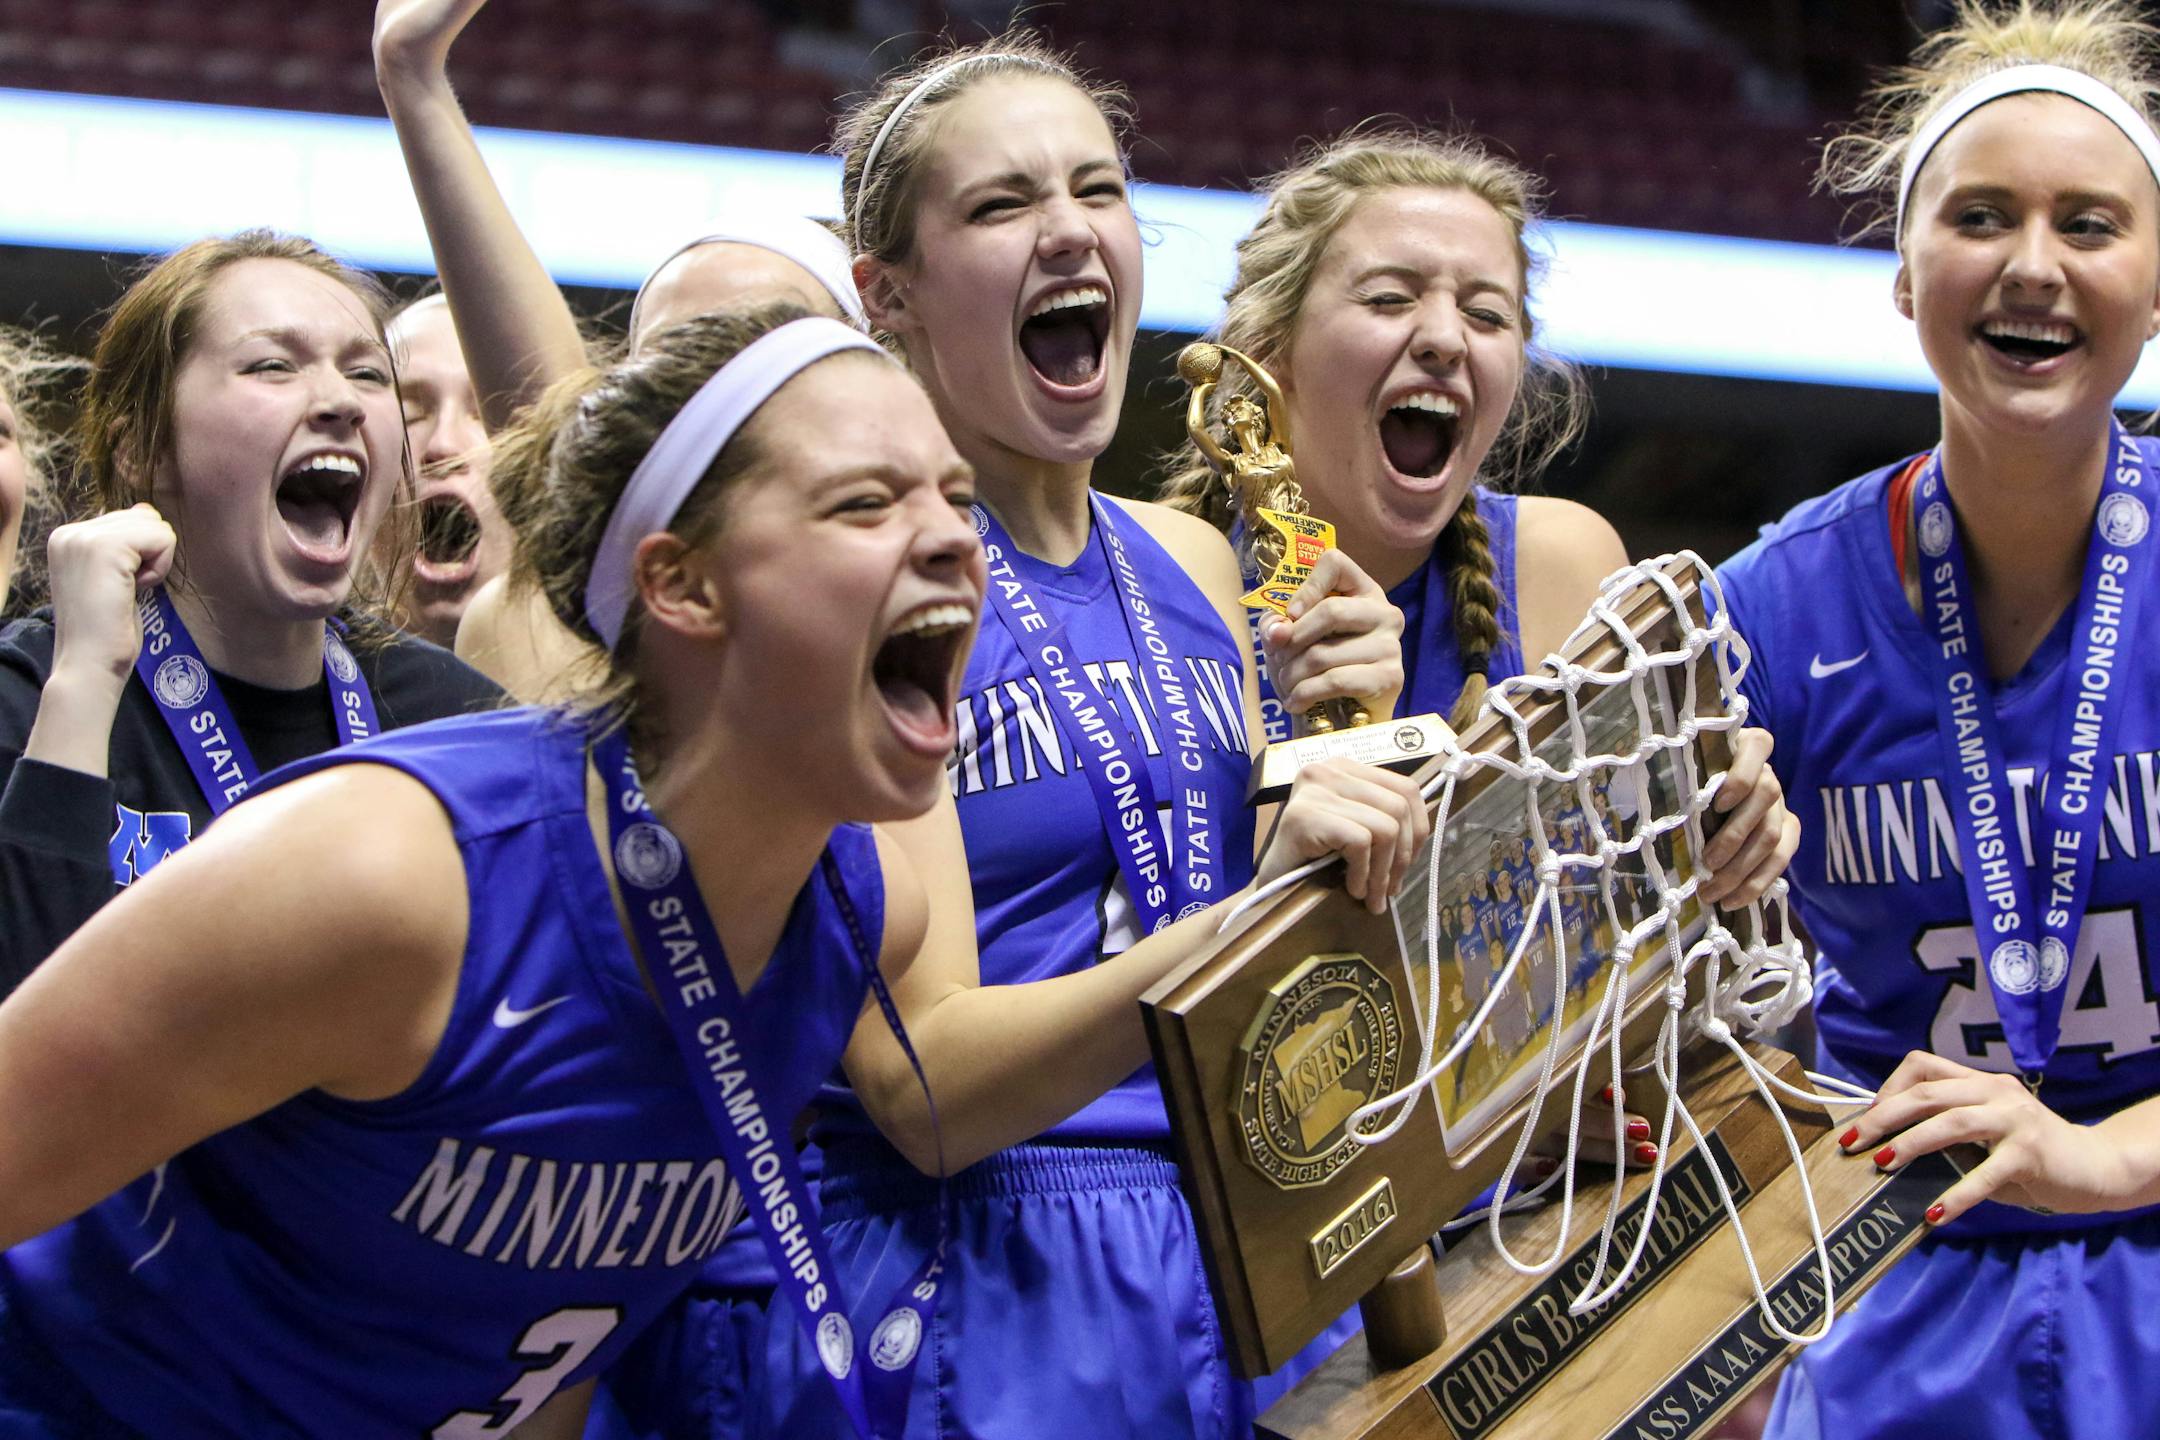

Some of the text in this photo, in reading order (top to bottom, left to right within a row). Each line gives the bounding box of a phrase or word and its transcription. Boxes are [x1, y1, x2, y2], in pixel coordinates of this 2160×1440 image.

[1106, 532, 1203, 772] CHAMPIONSHIPS
[1933, 561, 1967, 660] STATE
[984, 543, 1167, 908] STATE CHAMPIONSHIPS
[2060, 553, 2129, 815] CHAMPIONSHIPS
[190, 711, 250, 804] STATE
[1947, 670, 2021, 934] CHAMPIONSHIPS
[1184, 788, 1212, 893] STATE
[2046, 829, 2082, 929] STATE
[1506, 913, 1517, 930] 12
[1532, 950, 1543, 967] 10
[1253, 965, 1360, 1062] MINNESOTA
[1294, 994, 1324, 1026] ARTS
[1915, 908, 2160, 1074] 24
[649, 896, 828, 1313] STATE CHAMPIONSHIPS
[1244, 1116, 1280, 1173] STATE
[1277, 1161, 1323, 1182] HIGH
[1379, 1001, 1399, 1093] LEAGUE
[1274, 1019, 1369, 1126] MSHSL
[1321, 1191, 1391, 1268] 2016
[1685, 1332, 1769, 1414] AAAA
[1758, 1199, 1906, 1340] CHAMPION
[431, 1308, 620, 1440] 3
[1441, 1312, 1550, 1431] GIRLS
